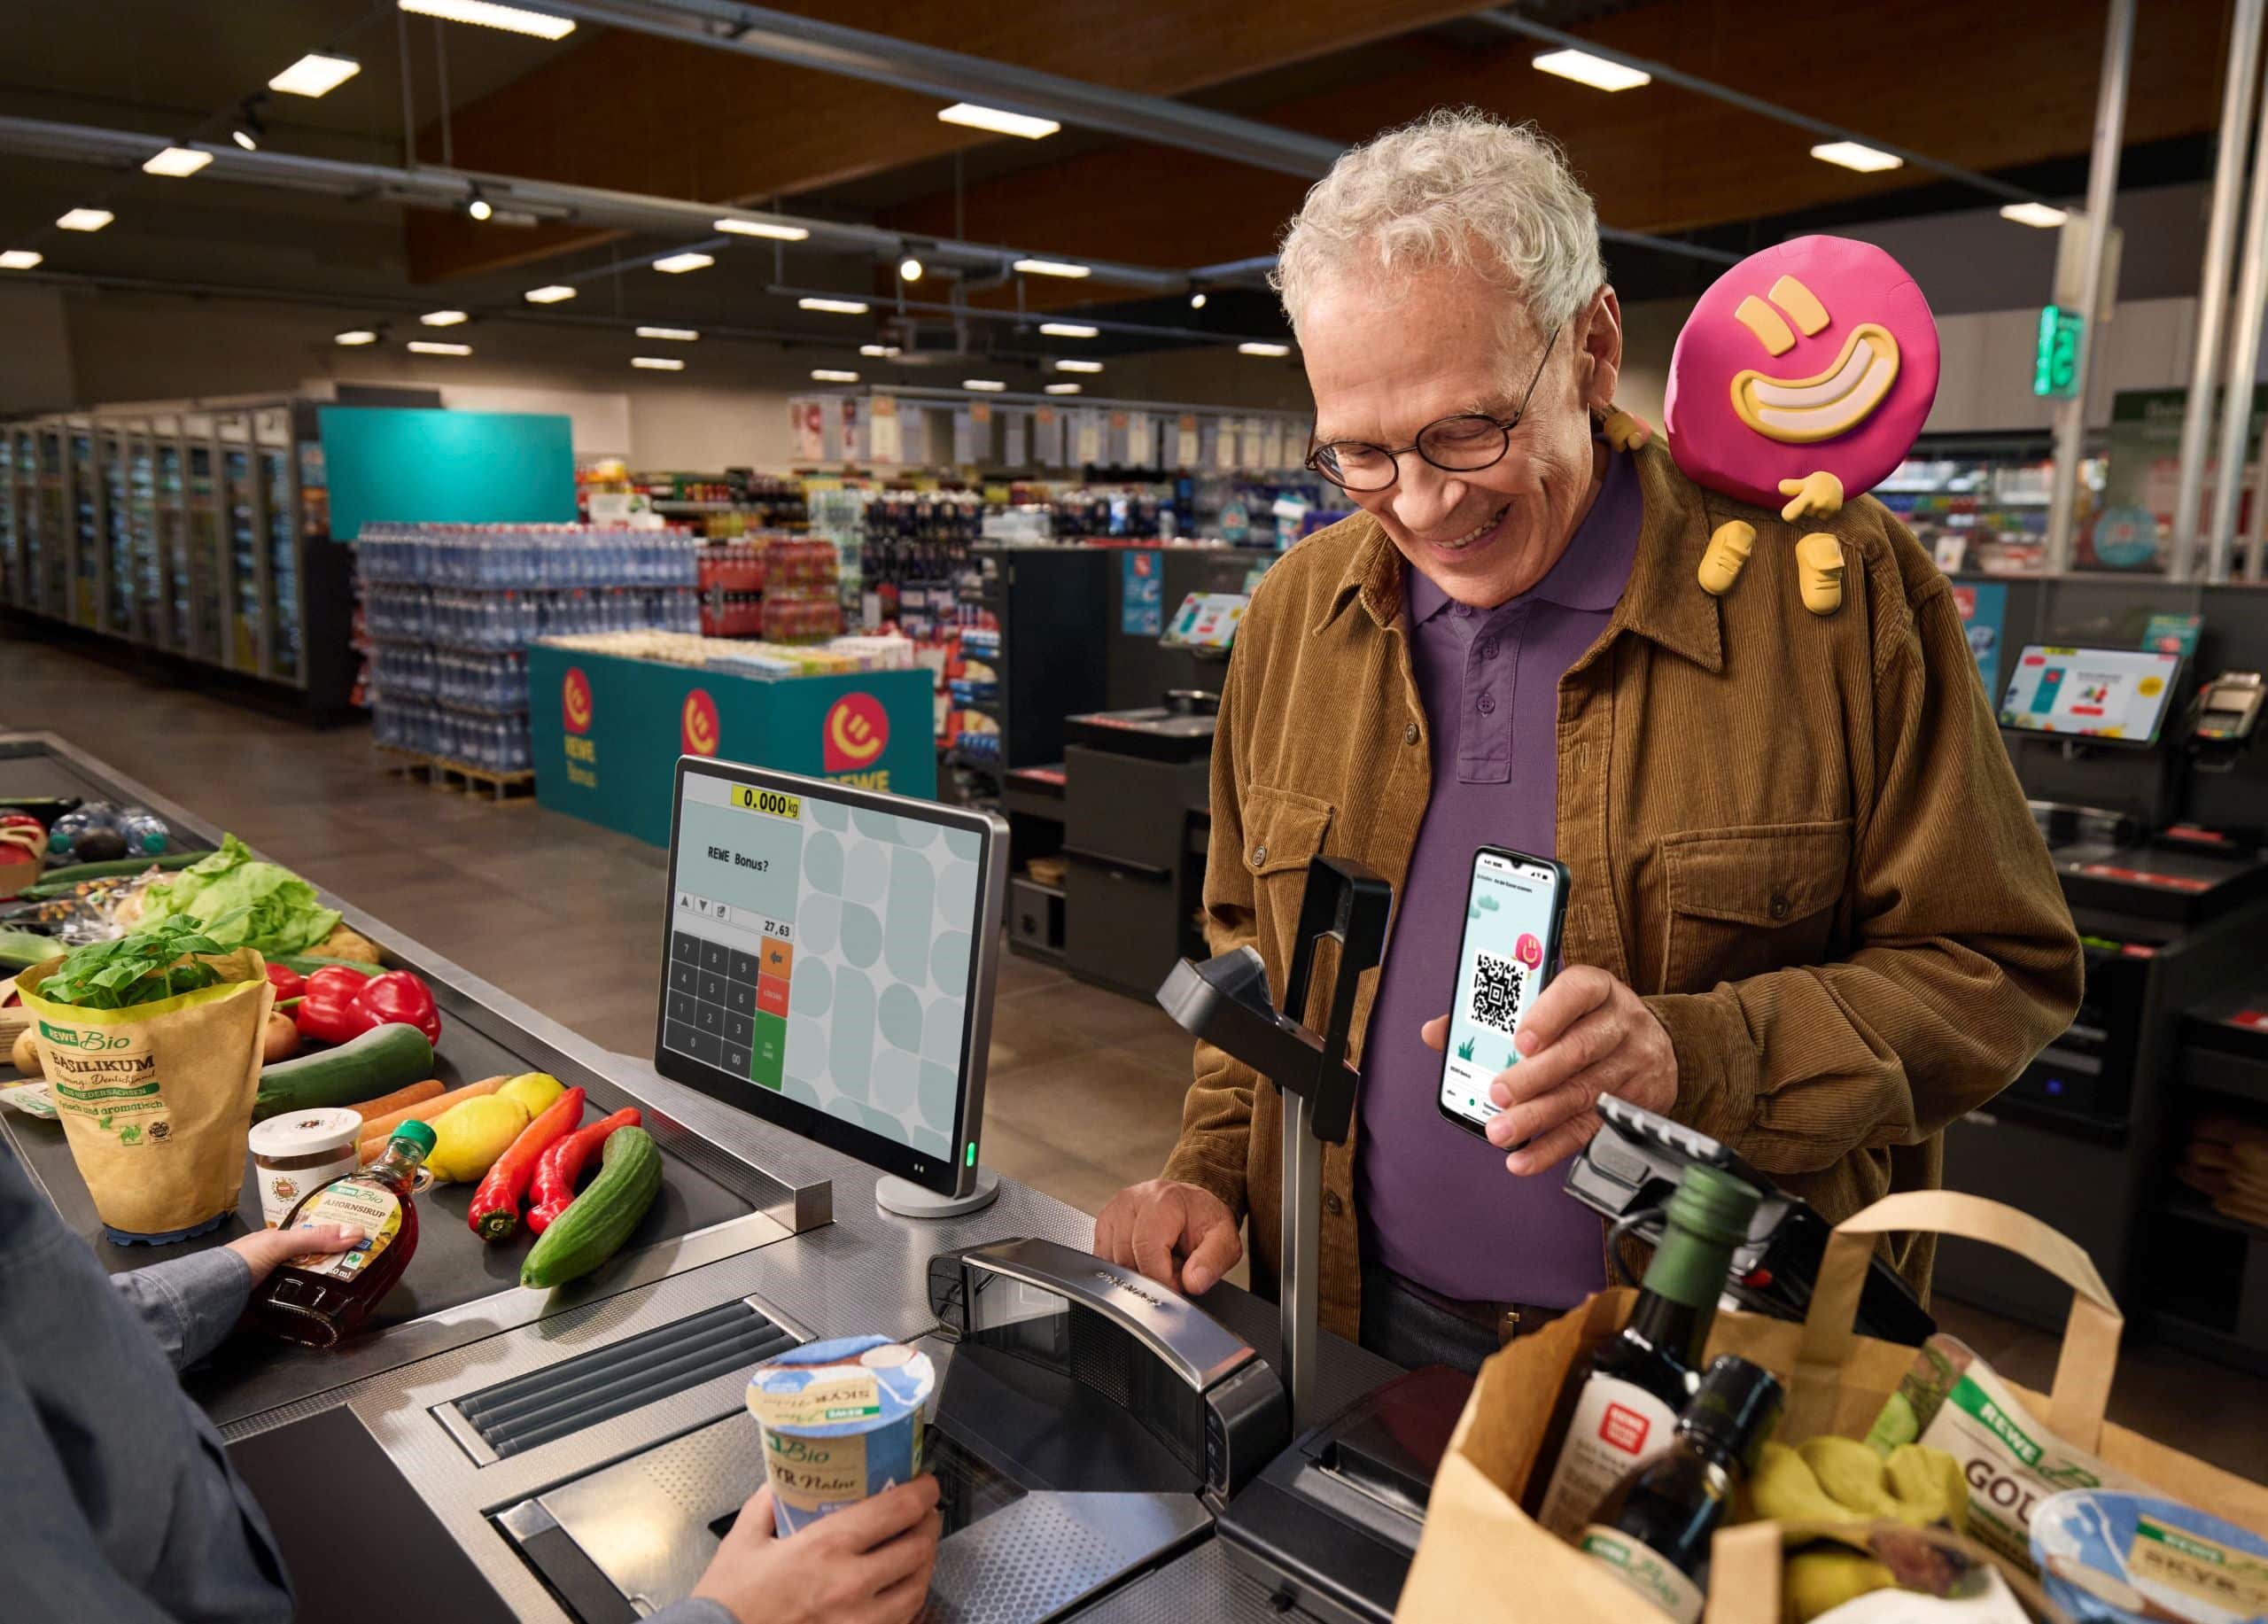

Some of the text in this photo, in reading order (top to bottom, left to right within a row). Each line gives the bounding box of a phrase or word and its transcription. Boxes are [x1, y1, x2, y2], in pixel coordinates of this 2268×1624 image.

[743, 789, 798, 817] 0.000 kg
[708, 845, 769, 872] REWE Bonus?
[765, 921, 789, 937] 27,63
[684, 943, 689, 954] 7
[741, 962, 747, 973] 9
[709, 983, 715, 993] 5
[738, 993, 744, 1004] 6
[707, 1013, 712, 1023] 2
[736, 1023, 742, 1034] 3
[80, 1030, 130, 1051] Bio
[690, 1037, 741, 1065] 0 00
[50, 1051, 155, 1073] BASILIKUM
[101, 1100, 163, 1115] aromatisch
[356, 1190, 384, 1204] Bio
[323, 1199, 386, 1218] AHORNSIRUP
[1980, 1402, 2038, 1463] REWE
[781, 1441, 830, 1464] Bio
[799, 1473, 858, 1489] Natur
